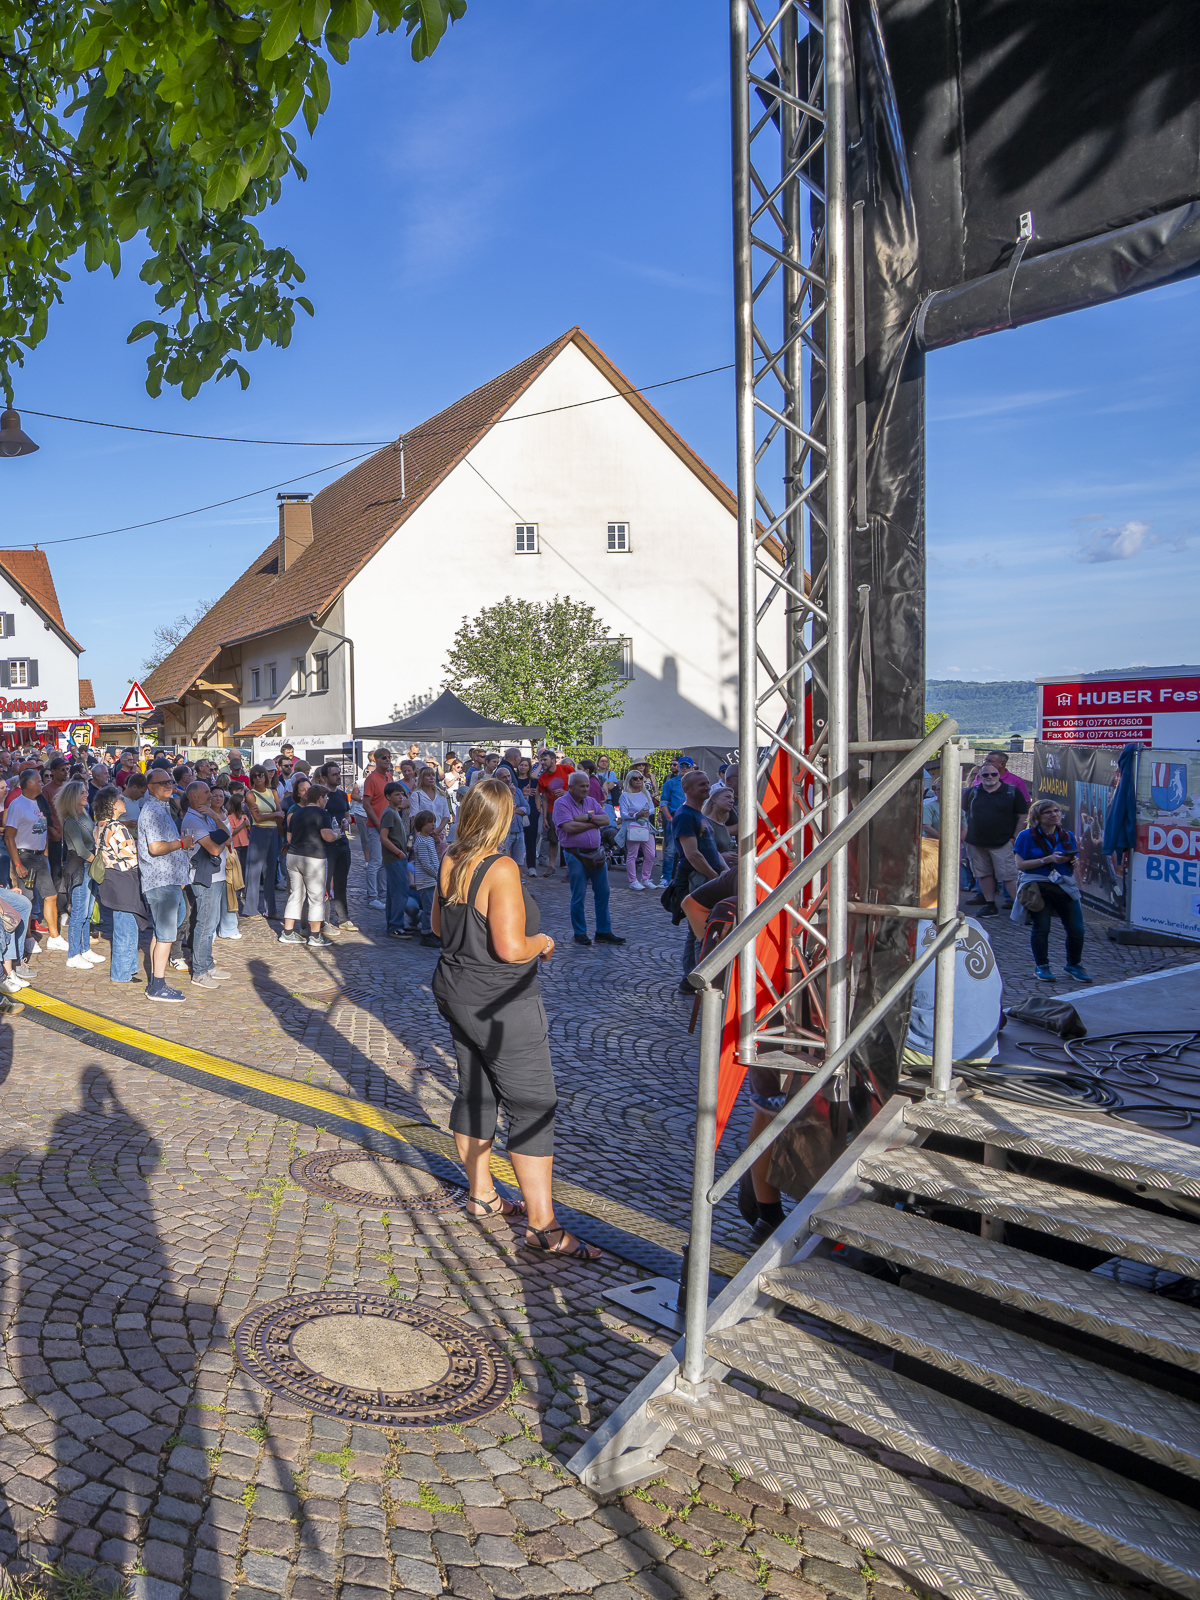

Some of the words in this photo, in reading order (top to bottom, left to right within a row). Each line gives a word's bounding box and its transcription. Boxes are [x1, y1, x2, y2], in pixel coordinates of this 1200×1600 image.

[1077, 689, 1153, 706] HUBER
[1159, 688, 1200, 702] Fes
[1063, 719, 1084, 727] 0049
[1086, 730, 1143, 739] (0)7761/3444
[1038, 776, 1069, 798] JAMARAM
[1146, 856, 1200, 888] BRE
